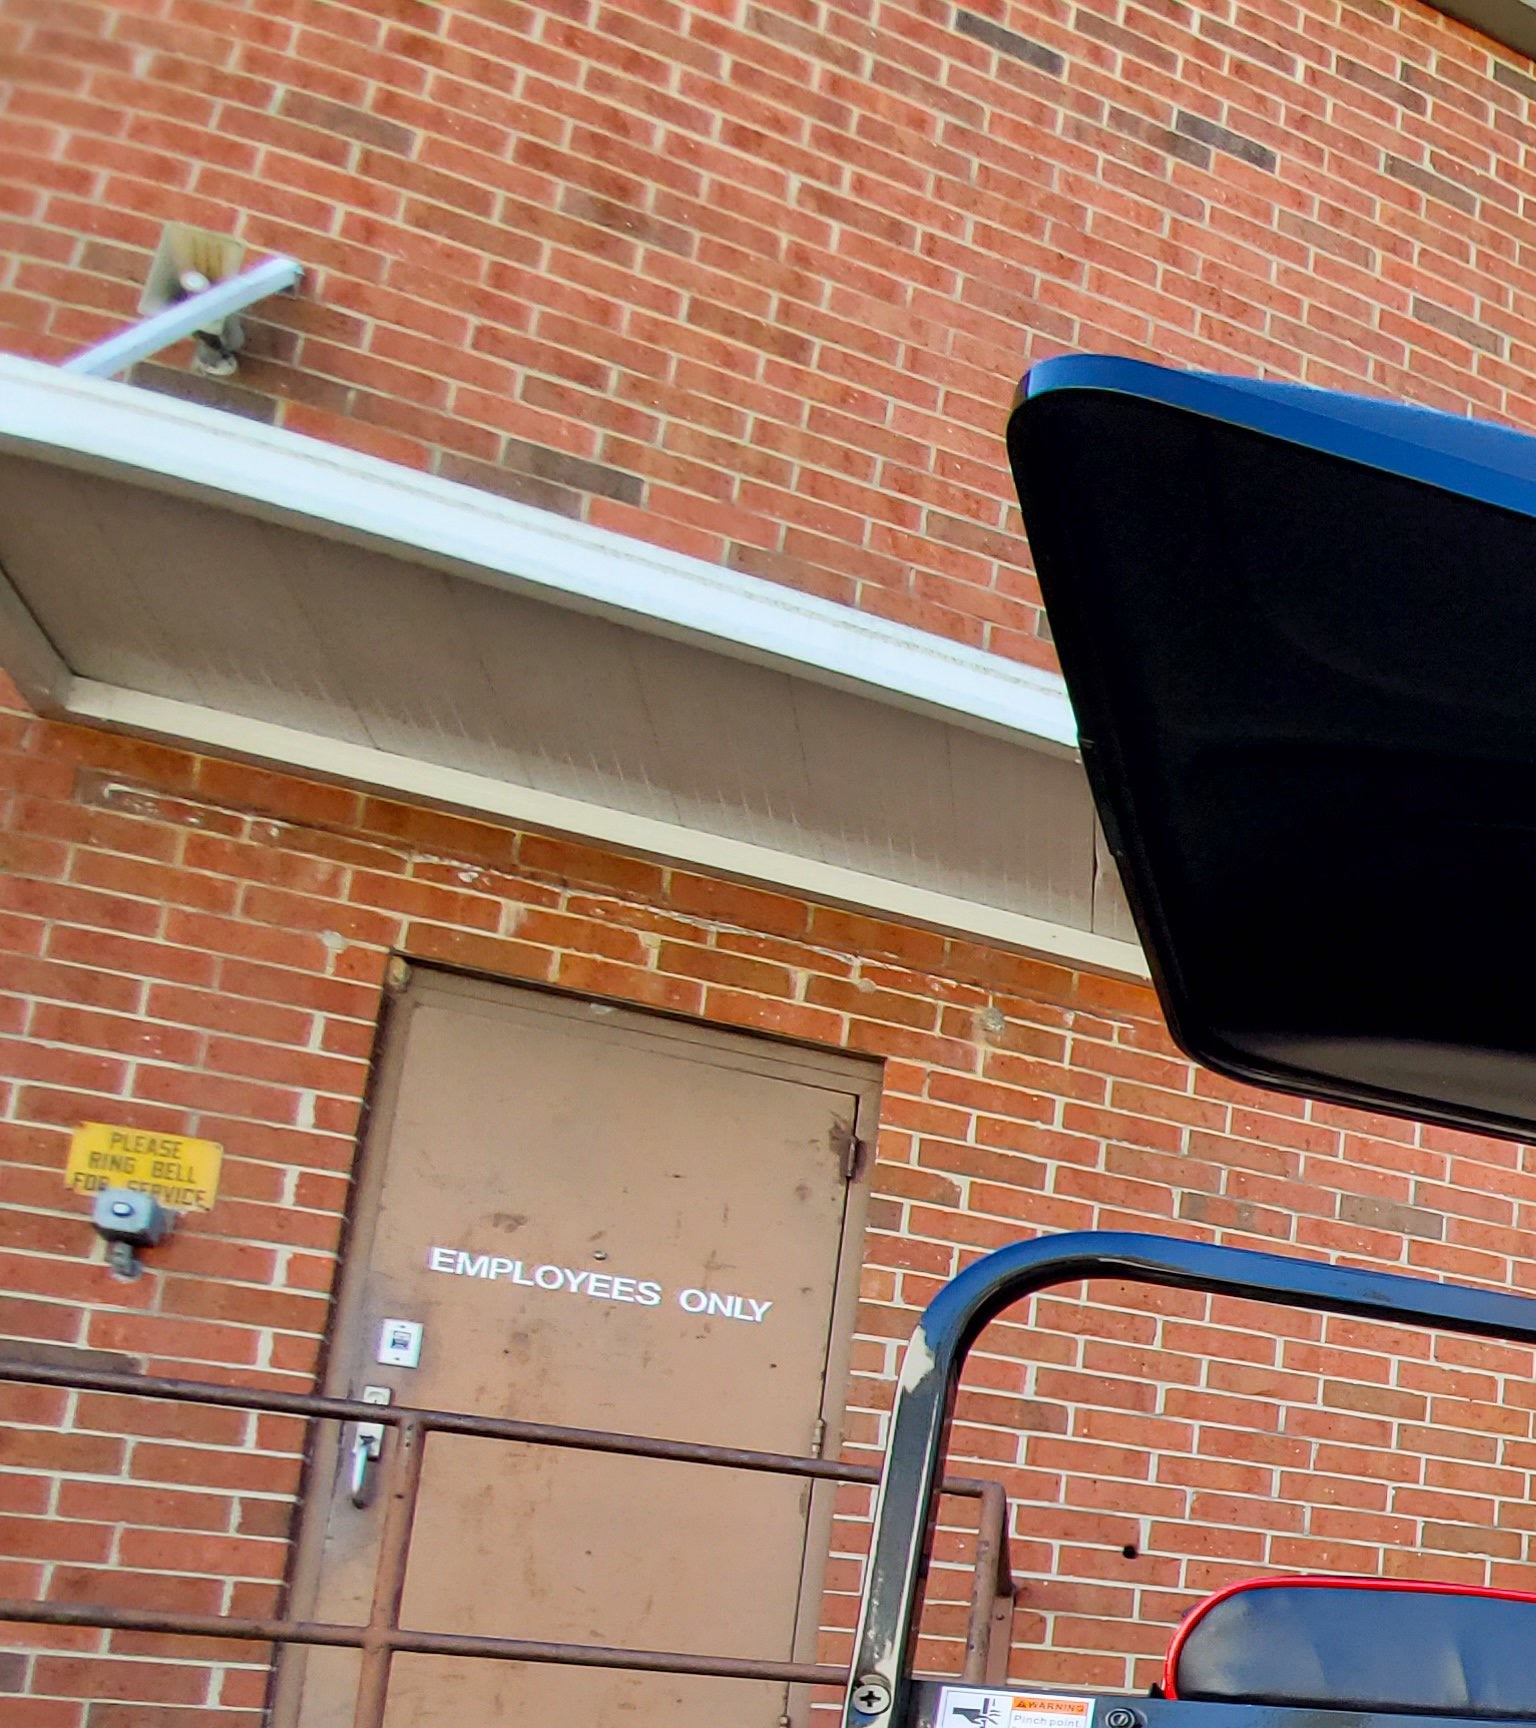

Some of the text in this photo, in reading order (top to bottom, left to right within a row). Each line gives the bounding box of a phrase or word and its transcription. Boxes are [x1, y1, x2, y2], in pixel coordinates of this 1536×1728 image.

[110, 1131, 184, 1159] PLEASE
[88, 1151, 196, 1184] RING BELL
[73, 1172, 110, 1192] FOR
[430, 1247, 773, 1322] EMPLOYEES ONLY
[1028, 1701, 1085, 1713] WARNING
[1014, 1715, 1047, 1725] Pinch
